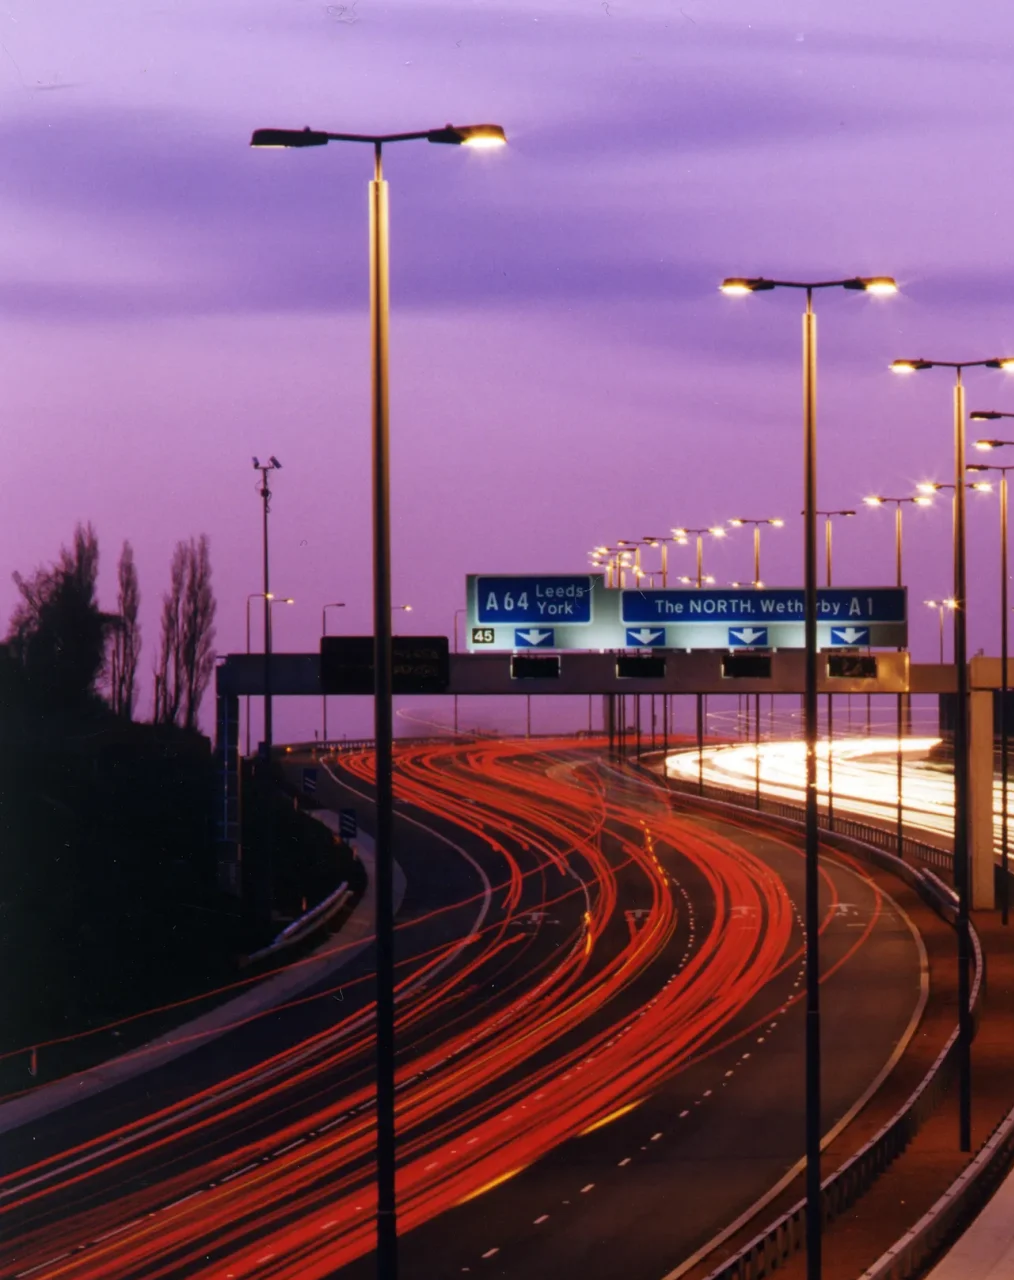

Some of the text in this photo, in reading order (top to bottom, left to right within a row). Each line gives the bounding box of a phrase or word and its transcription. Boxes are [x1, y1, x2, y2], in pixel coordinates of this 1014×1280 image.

[535, 584, 584, 598] Leeds
[537, 601, 574, 615] York
[654, 600, 684, 613] The
[760, 599, 841, 616] Wethrby
[473, 629, 493, 642] 45
